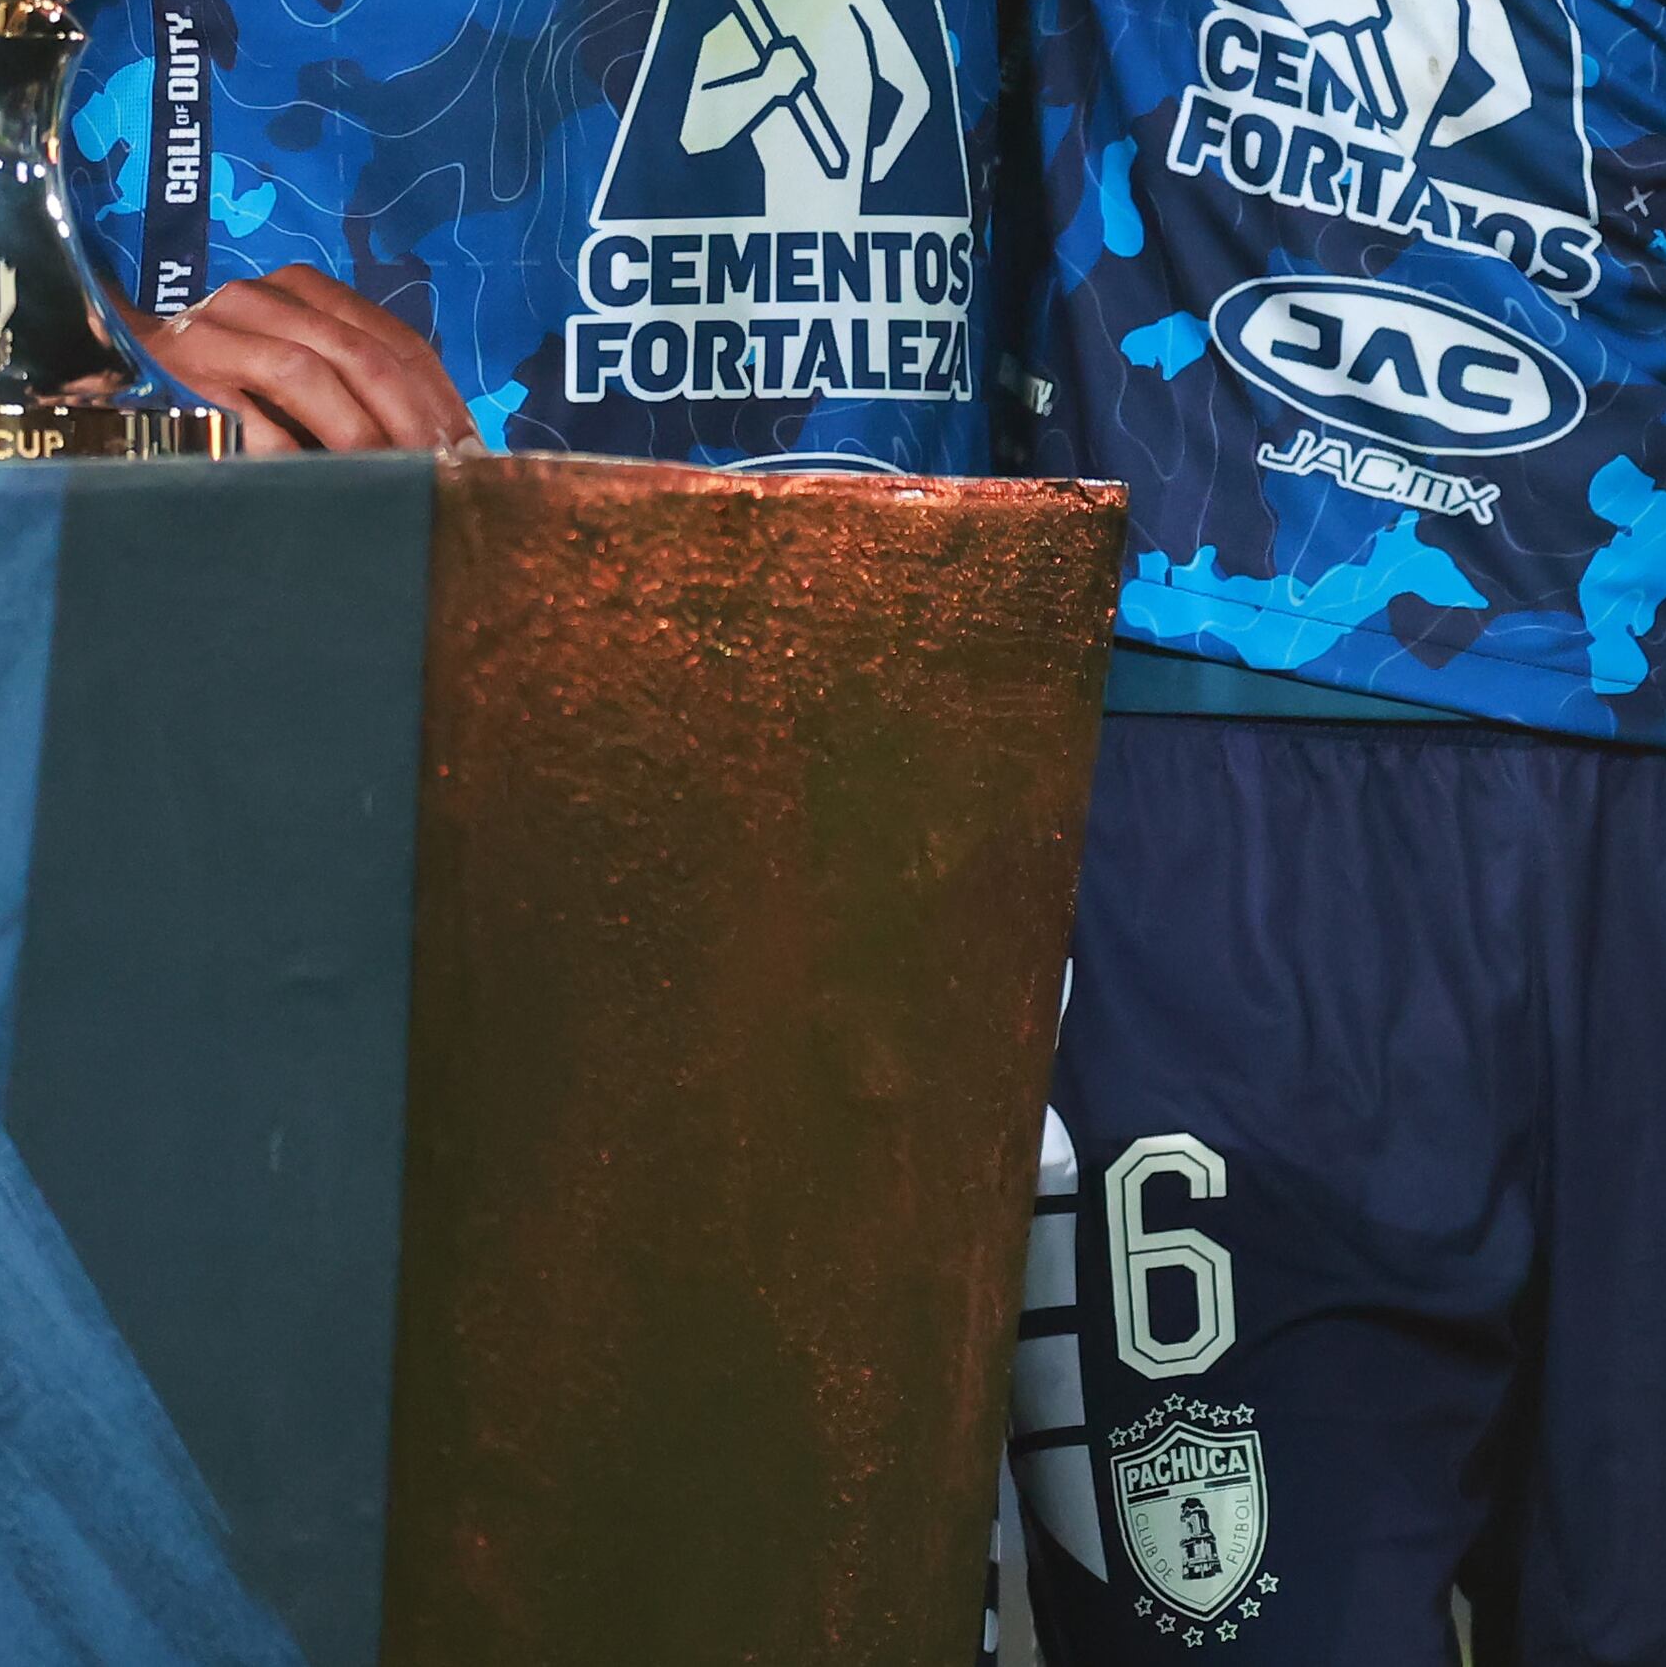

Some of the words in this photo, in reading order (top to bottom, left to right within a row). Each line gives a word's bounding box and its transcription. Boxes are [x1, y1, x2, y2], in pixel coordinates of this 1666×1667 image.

[165, 11, 201, 101] DUTY
[176, 104, 190, 125] OF
[164, 120, 201, 205] CALL
[588, 230, 971, 308] CEMENTOS
[574, 316, 971, 394] FORTALEZA
[1105, 1133, 1236, 1379] 6
[1126, 1446, 1247, 1493] PACHUCA
[1135, 1512, 1158, 1558] CLUB
[1154, 1559, 1175, 1583] DE
[1226, 1495, 1250, 1565] FUTBOL
